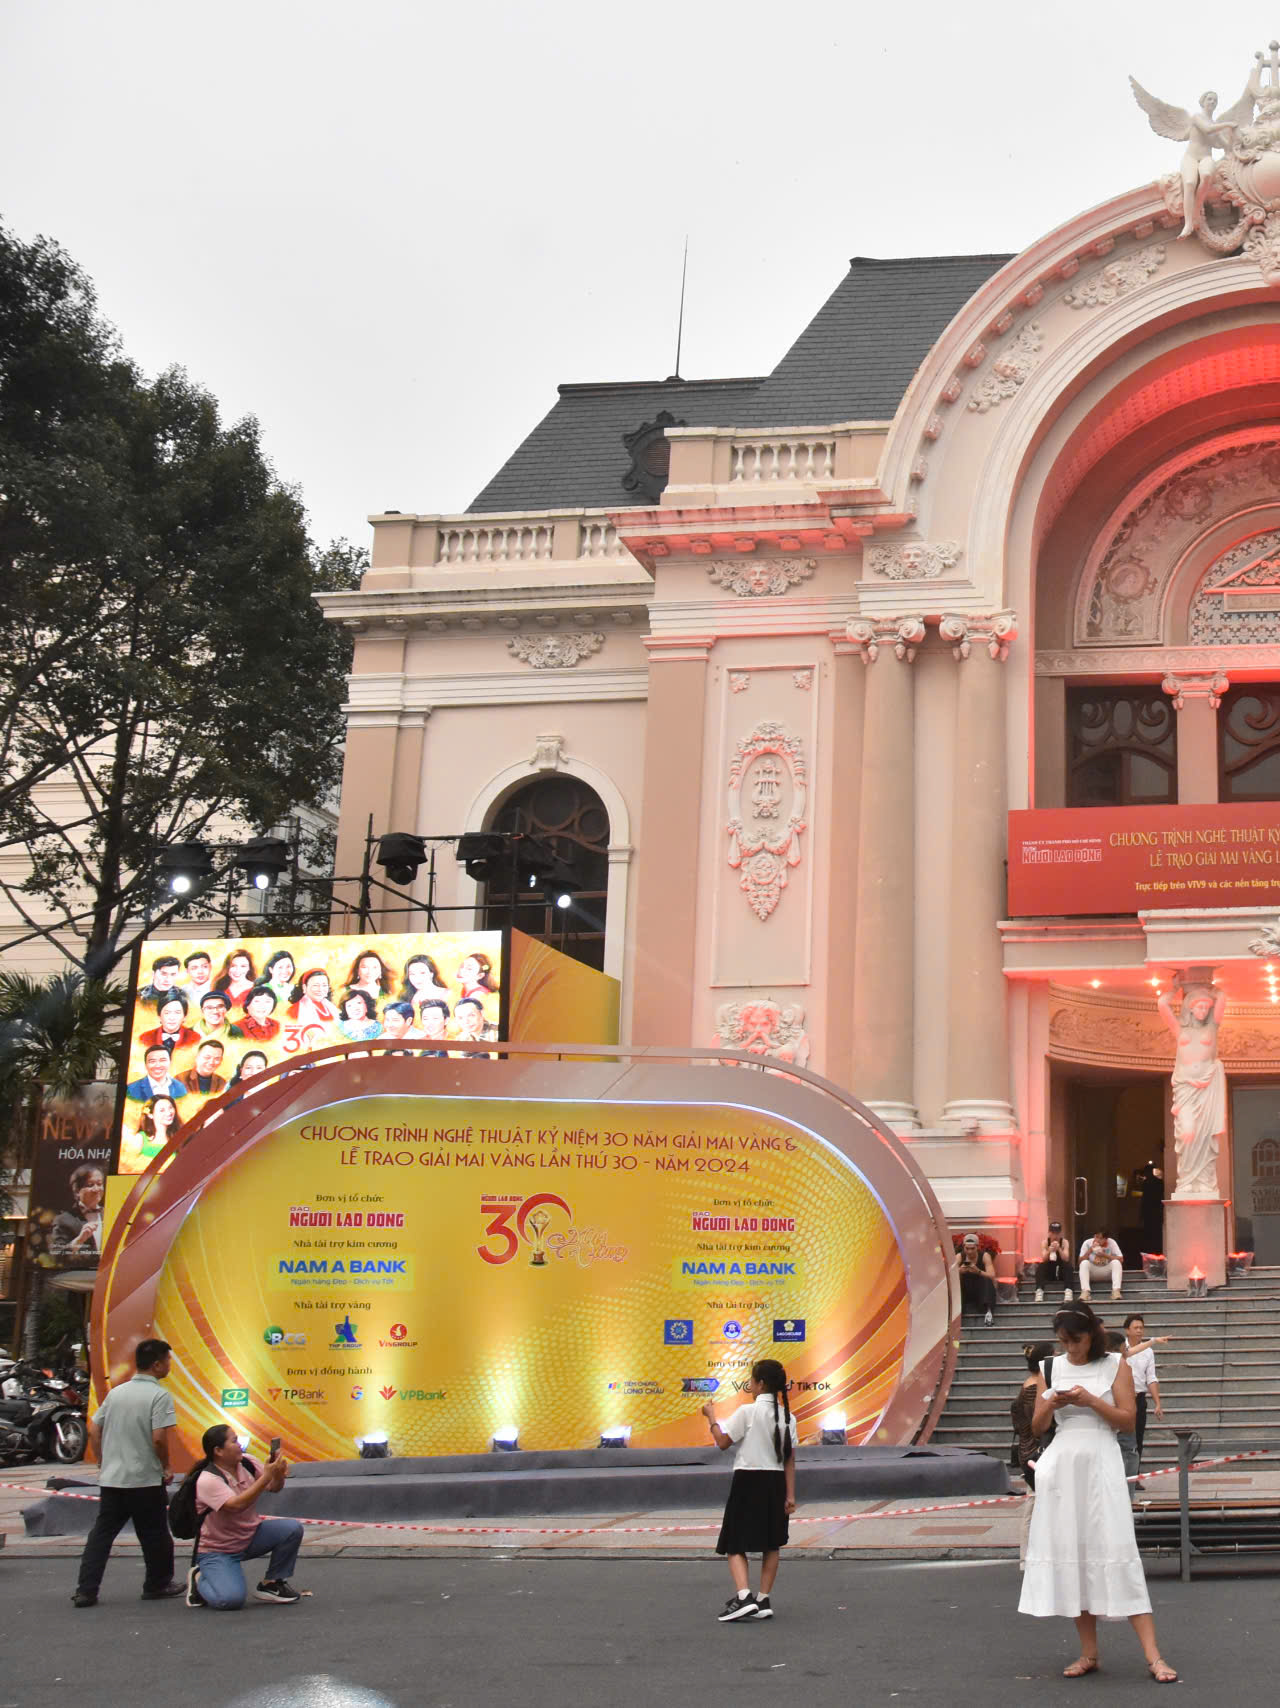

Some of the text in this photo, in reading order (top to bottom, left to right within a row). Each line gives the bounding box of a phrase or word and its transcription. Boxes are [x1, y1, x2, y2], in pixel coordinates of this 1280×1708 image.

[1166, 852, 1193, 869] TRAO
[1220, 851, 1239, 865] MAI
[385, 1121, 428, 1142] TRÌNH
[433, 1126, 473, 1147] NGHỆ
[480, 1126, 532, 1148] THUẬT
[564, 1128, 598, 1149] NIỆM
[603, 1132, 628, 1147] 30
[633, 1129, 667, 1148] NĂM
[672, 1130, 701, 1149] GIẢI
[706, 1136, 733, 1150] MAI
[738, 1131, 781, 1151] VÀNG
[784, 1137, 798, 1151] &
[59, 1146, 112, 1162] HÒA NHẠ
[341, 1145, 360, 1165] LỄ
[364, 1151, 414, 1166] TRAO
[419, 1146, 450, 1167] GIẢI
[455, 1152, 485, 1167] MAI
[490, 1148, 535, 1168] VÀNG
[540, 1146, 570, 1168] LẦN
[576, 1150, 608, 1169] THỨ
[612, 1155, 638, 1170] 30
[655, 1154, 689, 1171] NĂM
[694, 1157, 751, 1173] 2024
[336, 1212, 363, 1227] LAO
[735, 1217, 758, 1231] LAO
[477, 1193, 573, 1265] 30
[279, 1260, 327, 1273] NAM
[349, 1260, 407, 1273] BANK
[682, 1262, 726, 1275] NAM
[745, 1263, 797, 1275] BANK
[797, 1381, 832, 1391] TikTok
[284, 1389, 325, 1400] TPBank
[400, 1389, 447, 1401] VPBank
